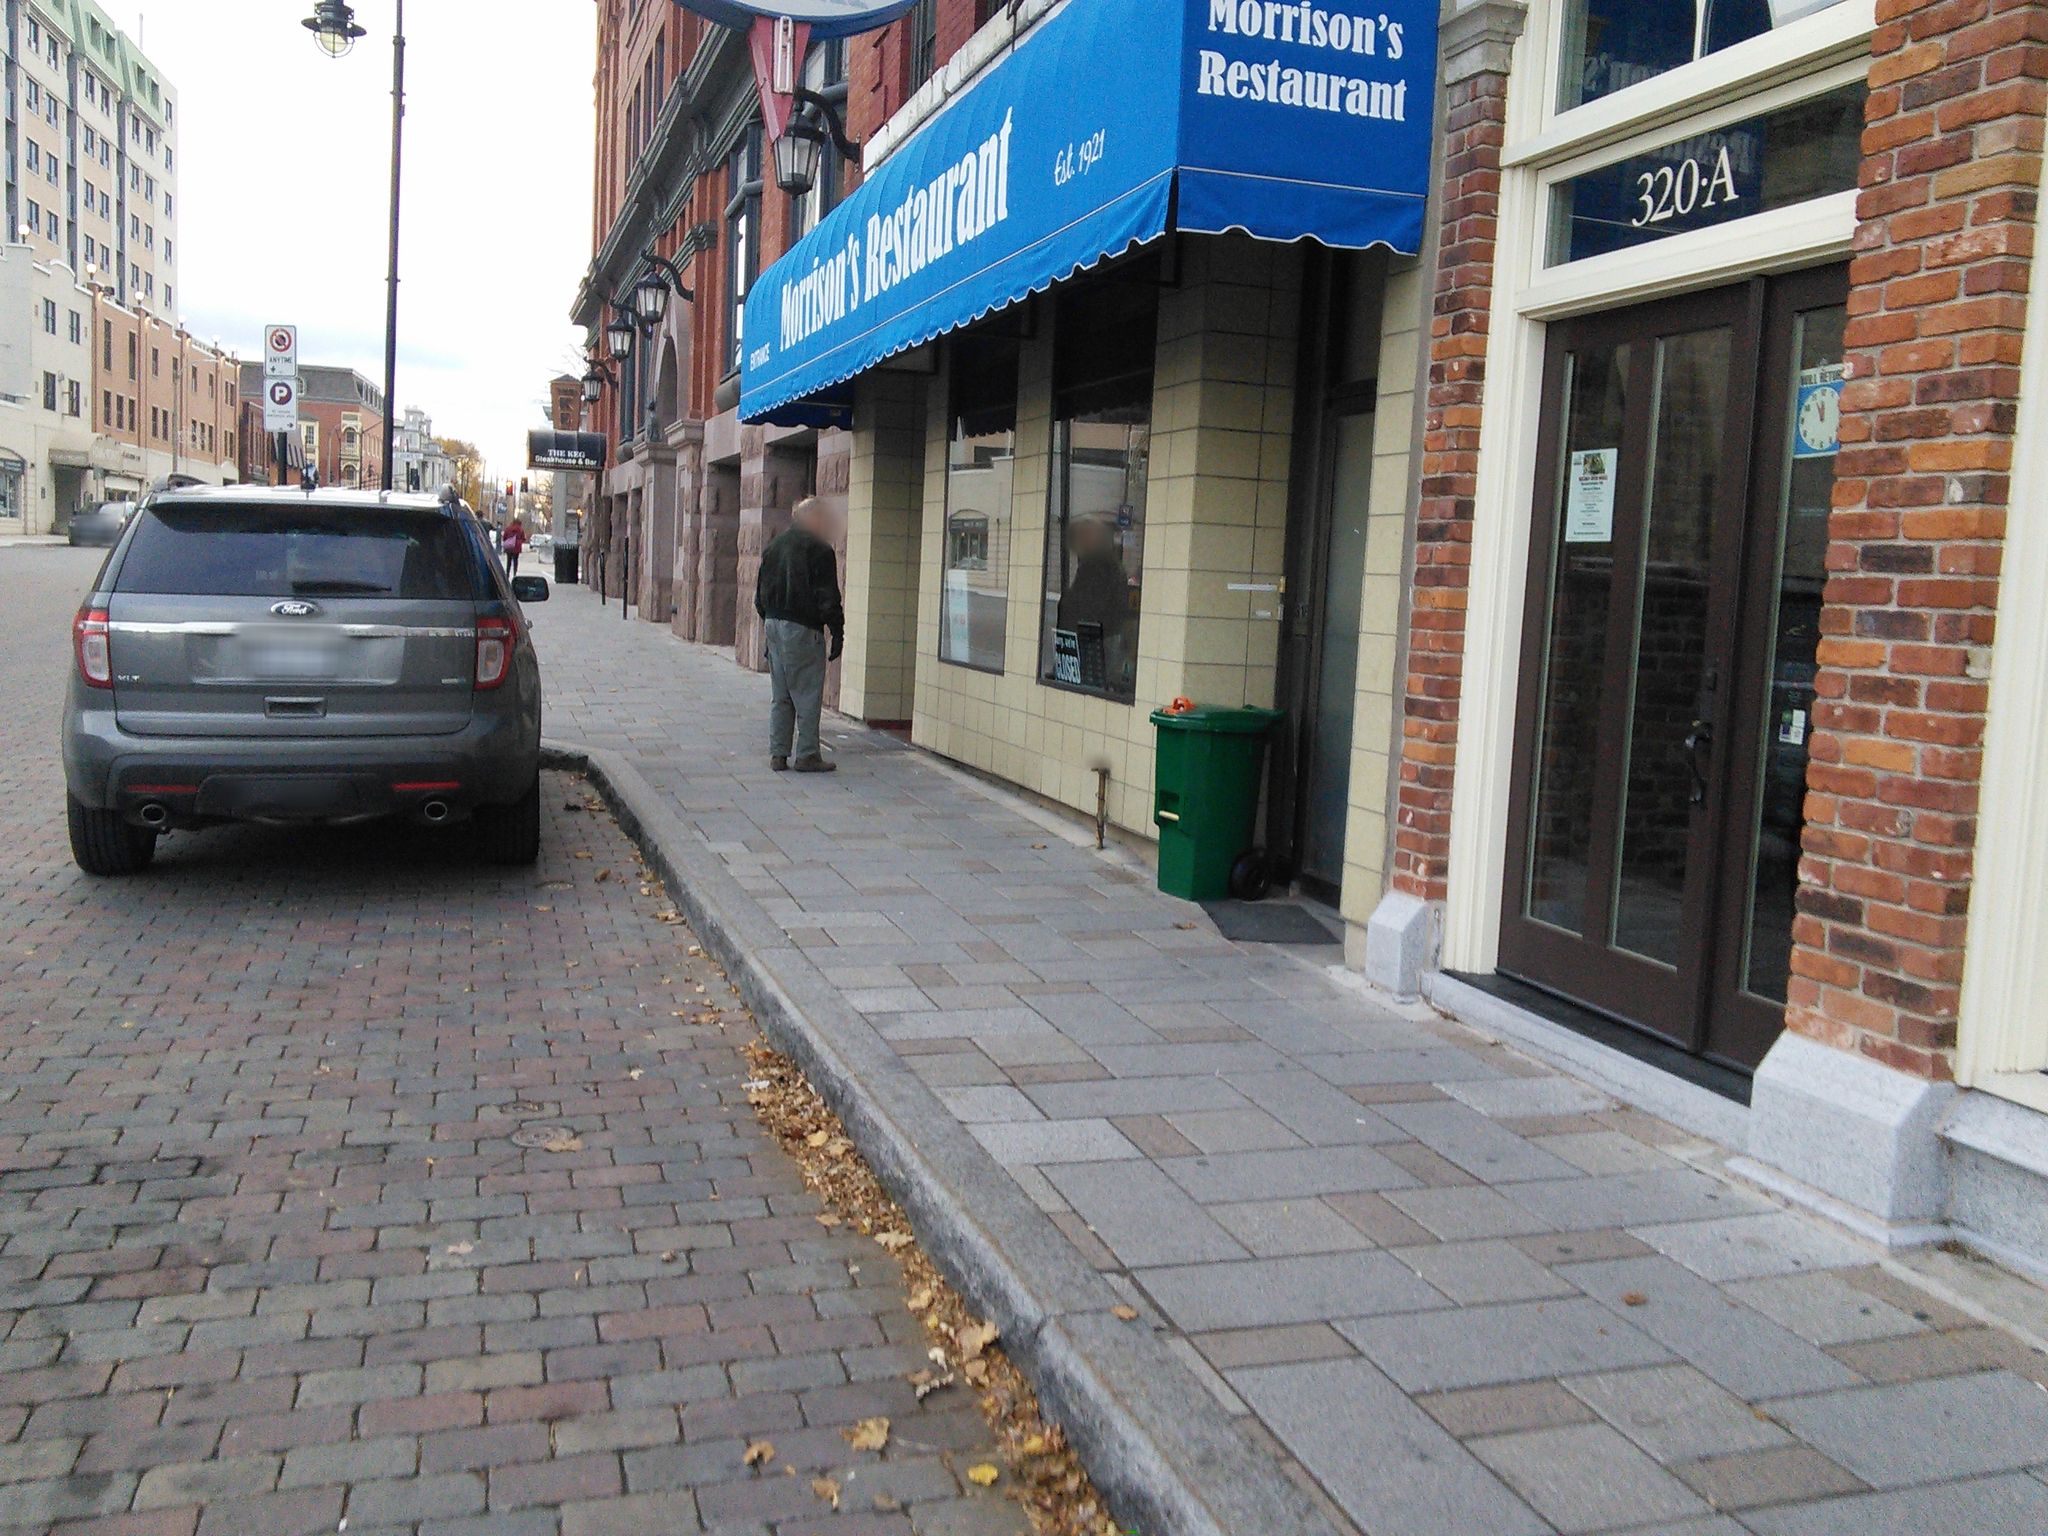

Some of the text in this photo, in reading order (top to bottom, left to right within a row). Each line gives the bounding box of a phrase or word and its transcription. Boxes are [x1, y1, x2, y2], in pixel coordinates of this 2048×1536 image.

[1208, 0, 1404, 60] Morrison's
[1197, 49, 1408, 121] Restaurant
[1054, 128, 1106, 187] Est. 1921
[780, 106, 1013, 352] Morrison's Restaurant
[269, 356, 293, 364] ANYTIME
[534, 455, 577, 465] Steakhouse
[584, 458, 598, 466] Bar
[547, 448, 586, 459] THE KEG
[281, 603, 308, 616] Ford
